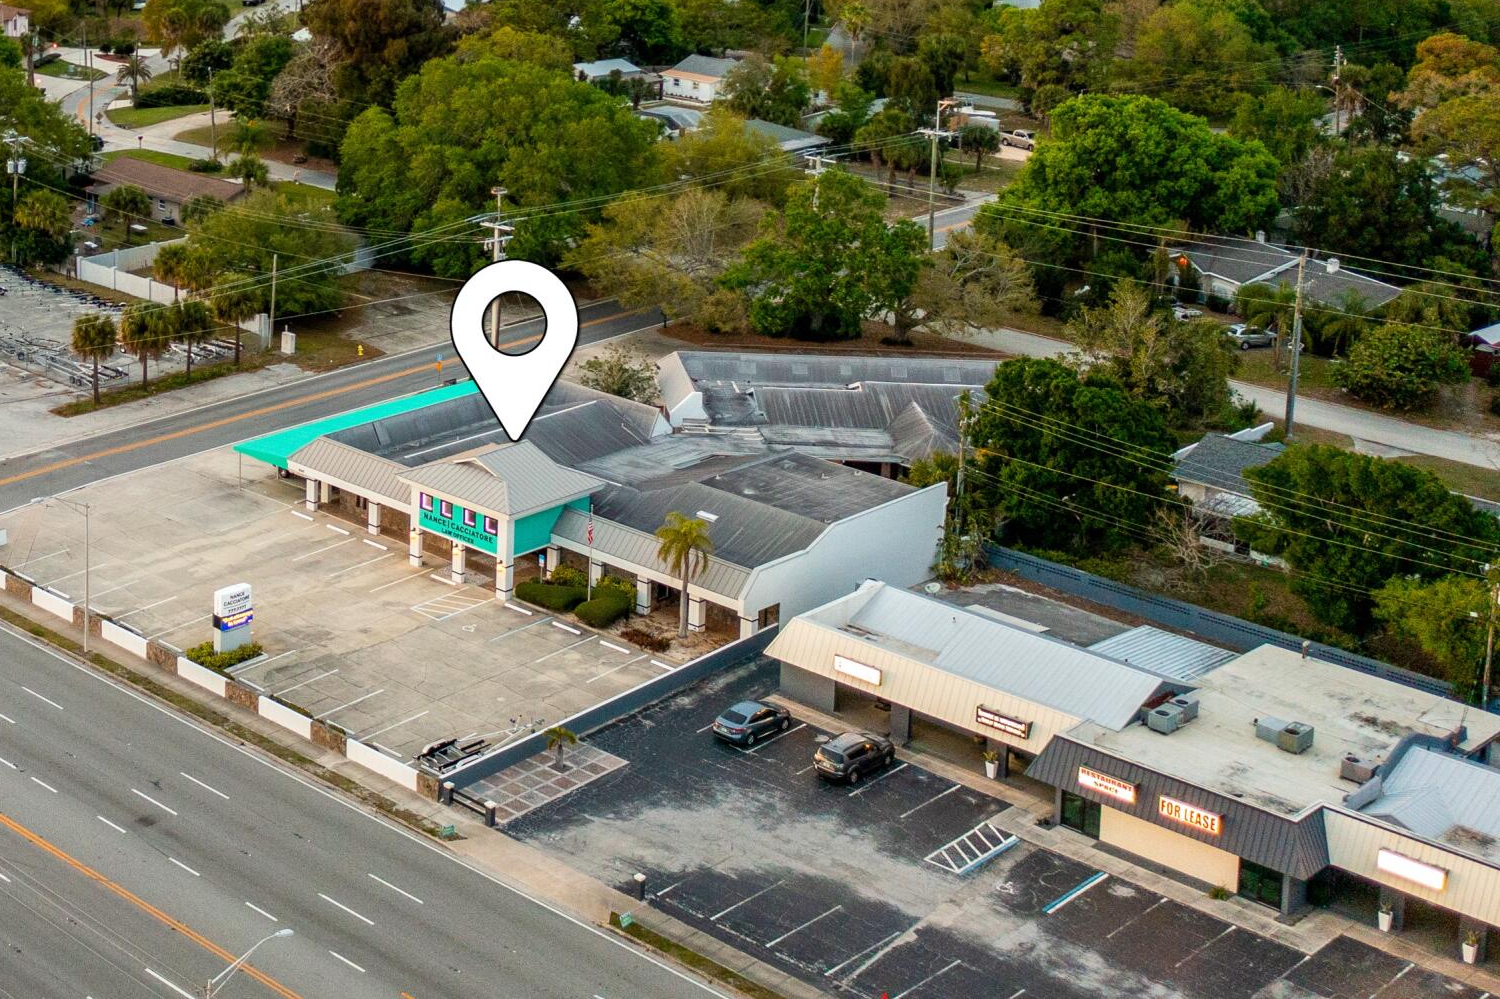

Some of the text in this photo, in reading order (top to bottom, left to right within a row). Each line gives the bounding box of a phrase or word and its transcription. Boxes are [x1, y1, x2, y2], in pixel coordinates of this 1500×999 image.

[423, 512, 493, 544] NANCE CACCIATORE
[1081, 767, 1132, 792] RESTAURANT
[1094, 780, 1119, 794] SPACE
[1161, 800, 1216, 832] FOR LEASE
